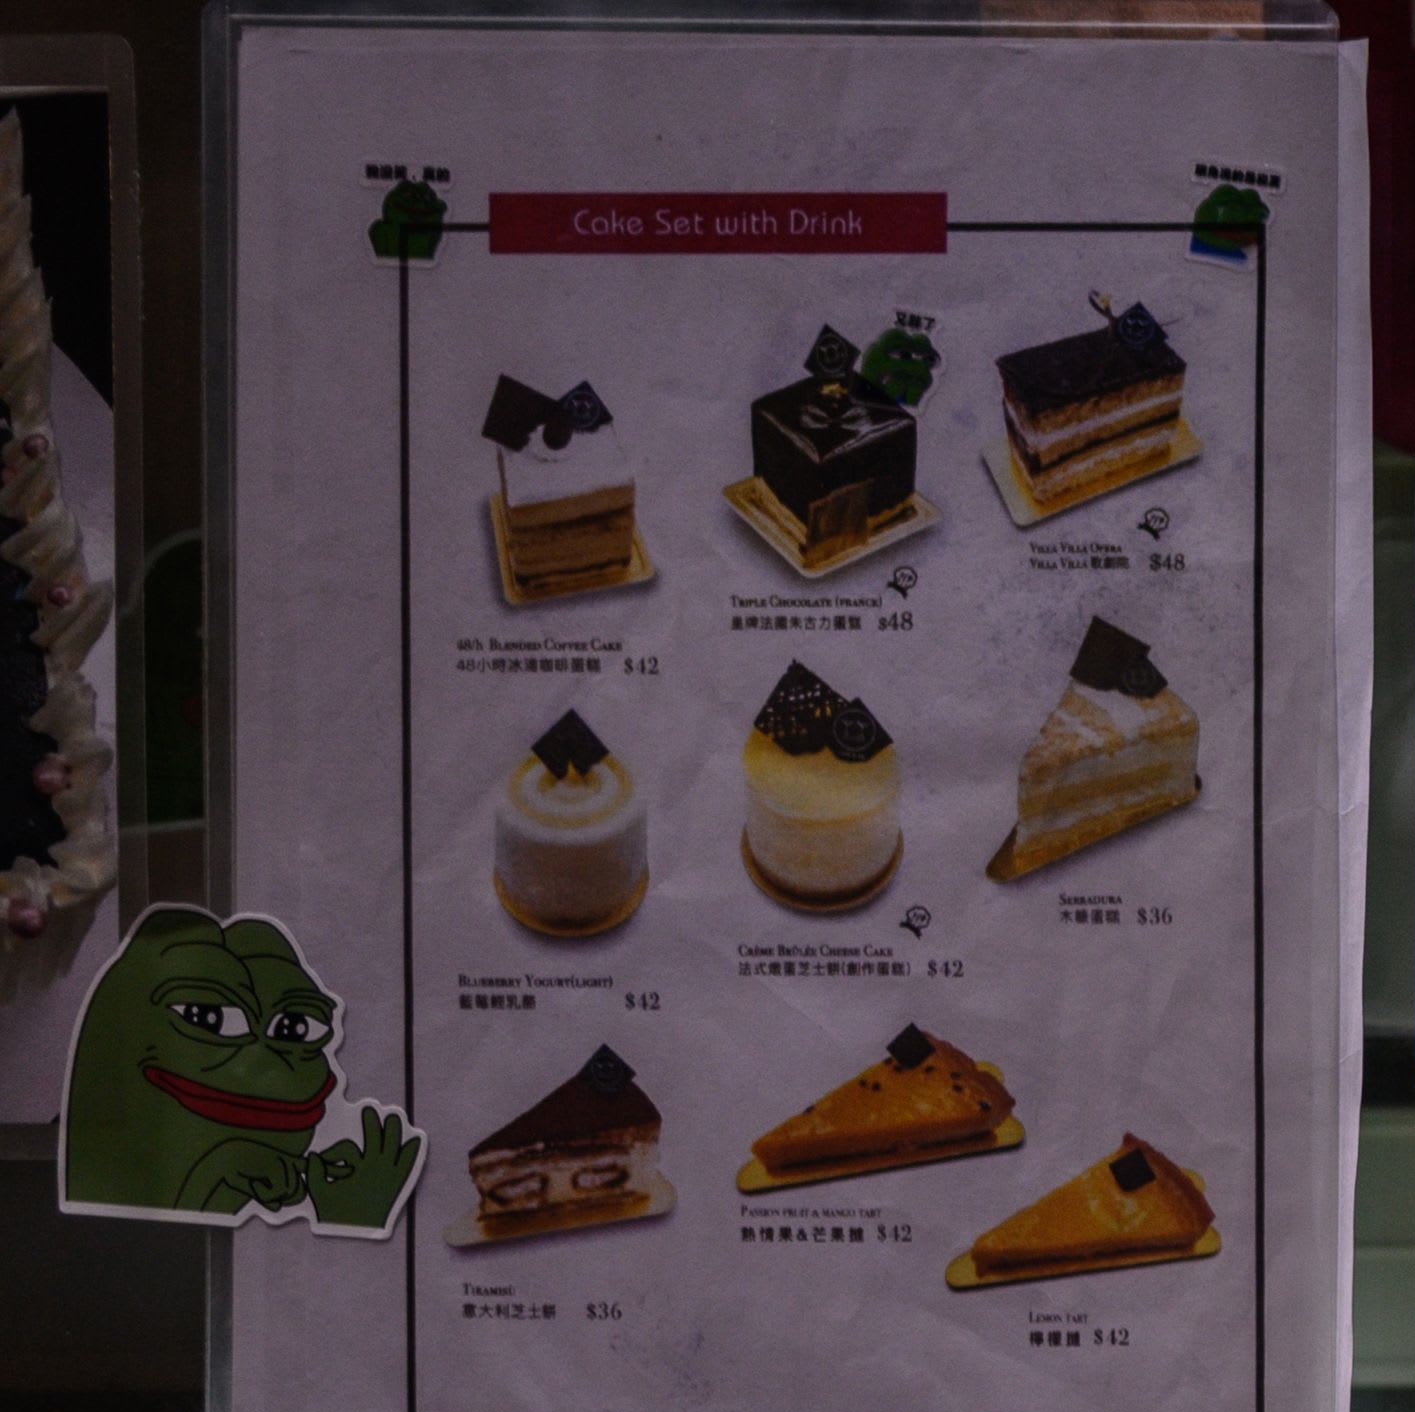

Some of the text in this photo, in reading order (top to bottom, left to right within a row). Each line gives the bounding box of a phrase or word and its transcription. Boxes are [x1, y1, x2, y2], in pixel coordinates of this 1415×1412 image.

[573, 208, 863, 236] Cake Set with Drink
[1149, 552, 1185, 572] $48
[878, 611, 913, 632] $48
[624, 656, 659, 675] $42
[1137, 906, 1173, 925] $36
[927, 959, 965, 978] $42
[625, 992, 661, 1010] $42
[877, 1224, 912, 1243] $42
[586, 1302, 623, 1321] $36
[1093, 1328, 1130, 1347] $42
